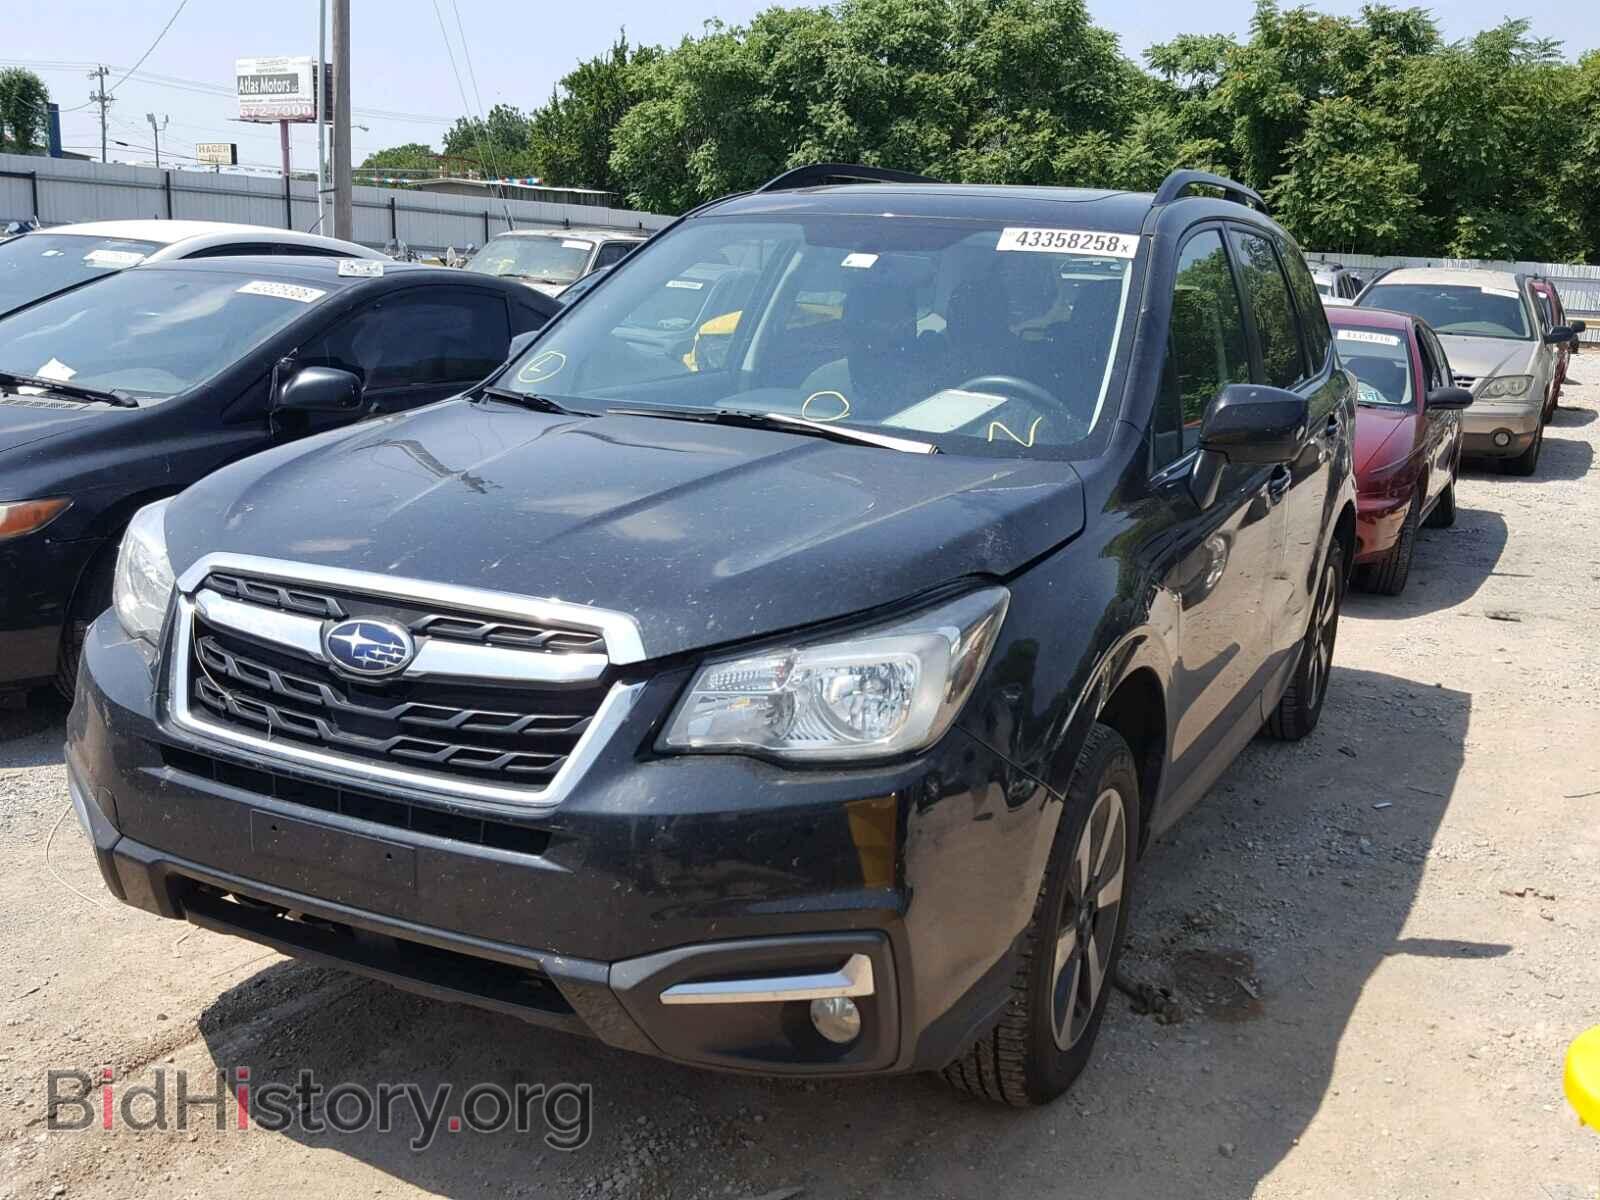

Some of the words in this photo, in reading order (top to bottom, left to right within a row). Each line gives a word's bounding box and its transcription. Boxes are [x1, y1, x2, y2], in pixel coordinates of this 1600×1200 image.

[239, 76, 258, 94] Atlas
[260, 75, 291, 94] Motors
[1016, 231, 1119, 252] 43358258
